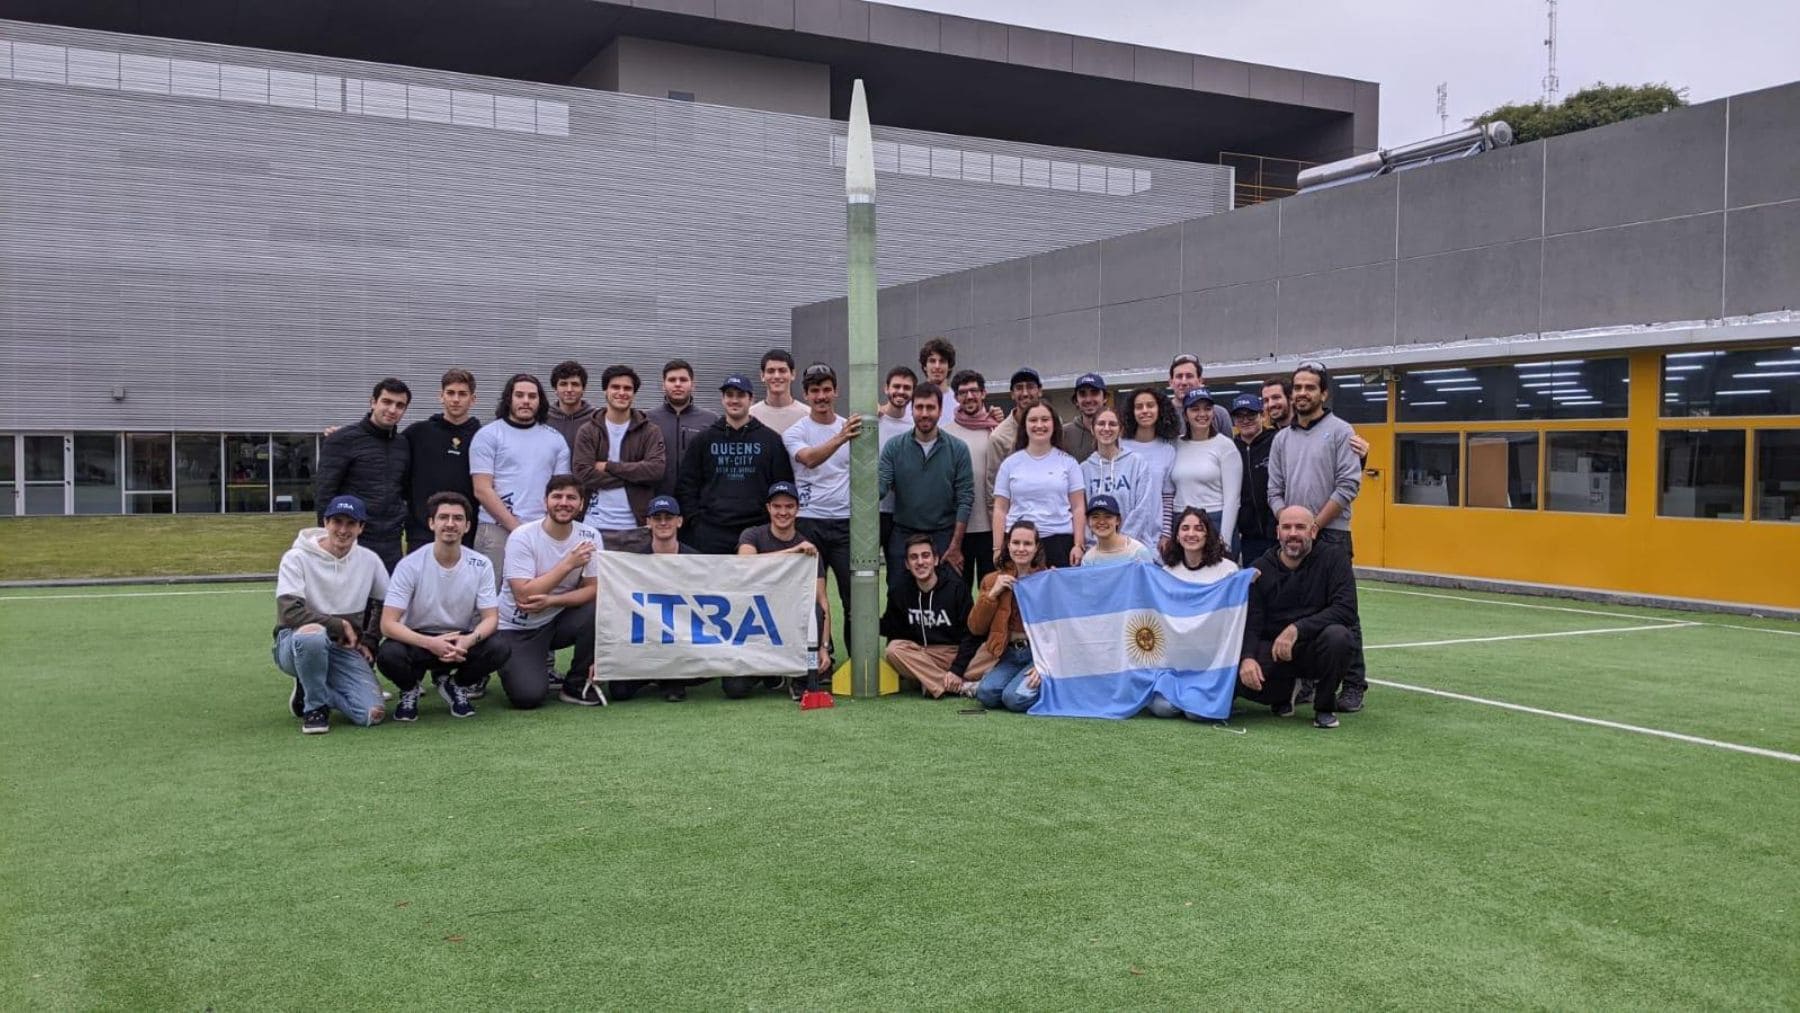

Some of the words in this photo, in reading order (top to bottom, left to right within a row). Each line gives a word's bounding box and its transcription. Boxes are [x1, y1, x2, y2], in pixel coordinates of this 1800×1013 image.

[710, 442, 761, 455] QUEENS
[631, 592, 783, 646] ITBA
[908, 608, 952, 627] ITBA
